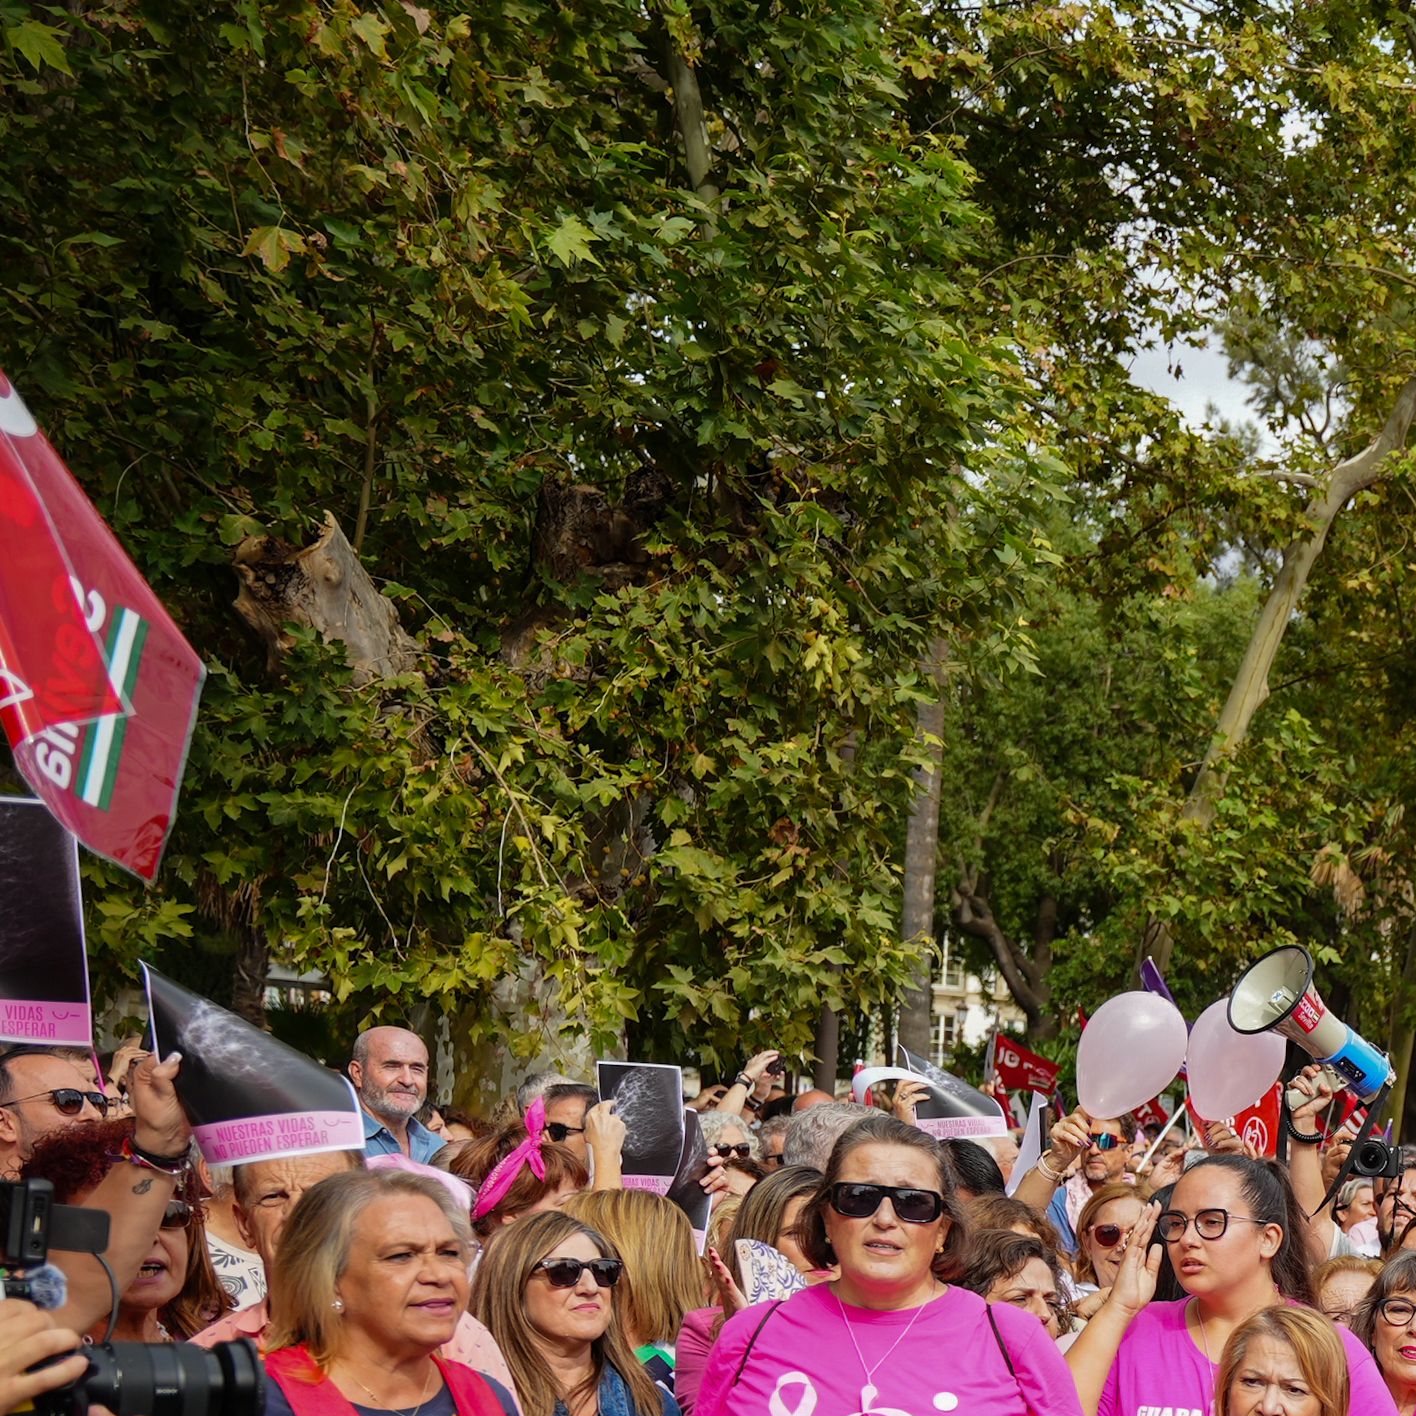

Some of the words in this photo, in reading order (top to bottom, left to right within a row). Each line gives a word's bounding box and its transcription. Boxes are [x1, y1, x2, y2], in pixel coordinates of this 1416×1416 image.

[5, 1005, 43, 1021] VIDAS
[1, 1021, 56, 1038] ESPERAR
[216, 1120, 274, 1143] NUESTRAS
[278, 1116, 315, 1134] VIDAS
[212, 1145, 227, 1160] NO
[230, 1137, 272, 1158] PUEDEN
[277, 1130, 329, 1151] ESPERAR
